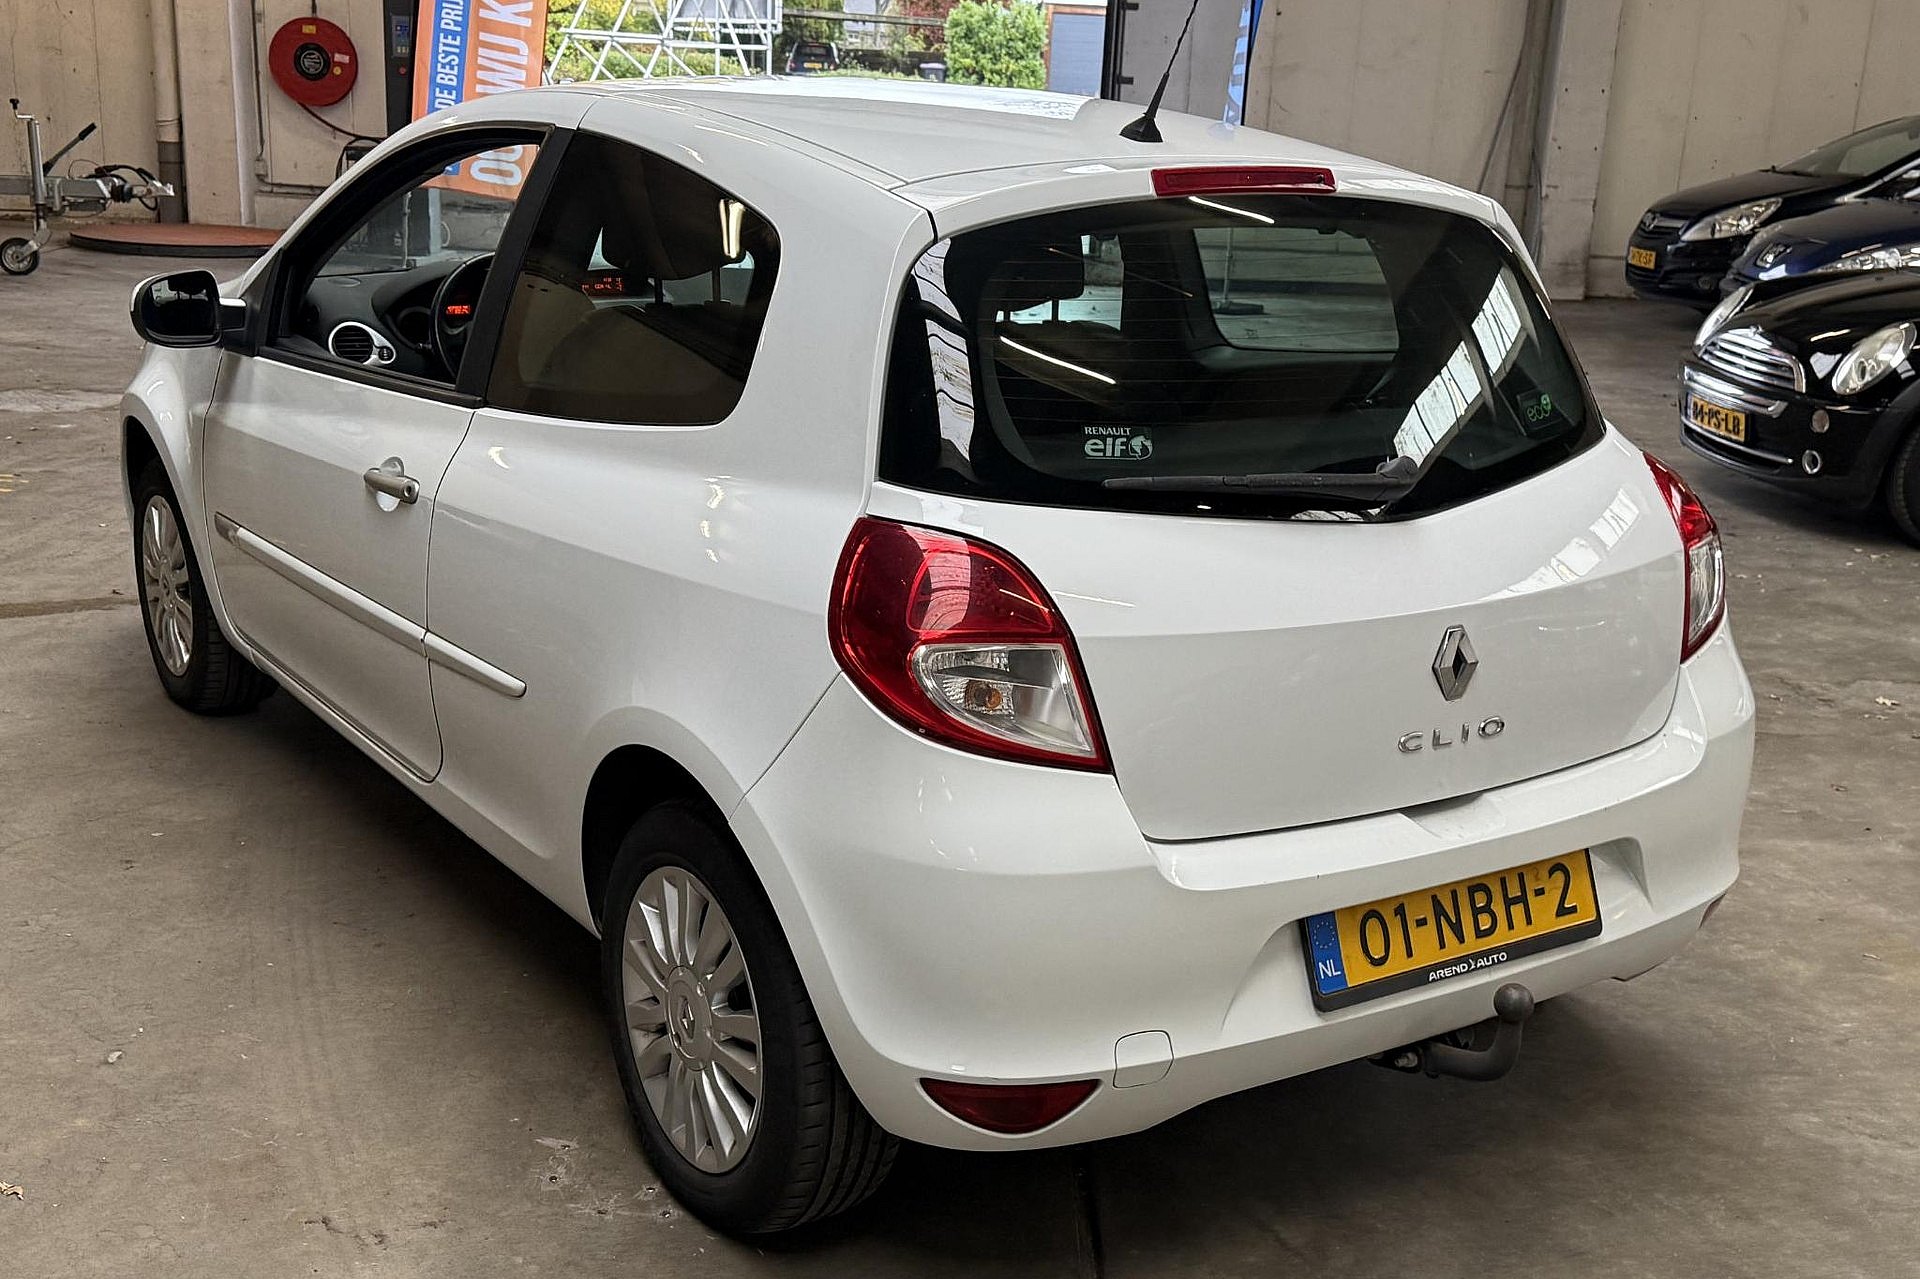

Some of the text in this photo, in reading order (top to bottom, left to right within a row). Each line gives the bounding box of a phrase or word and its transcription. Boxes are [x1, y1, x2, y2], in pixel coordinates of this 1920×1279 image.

[435, 33, 461, 87] BESTE
[475, 32, 529, 94] WIJ
[1084, 426, 1132, 436] RENAULT
[1084, 437, 1127, 457] elf
[1398, 716, 1504, 753] CLIO
[1359, 862, 1578, 967] 01-NBH-2
[1318, 961, 1341, 980] NL
[1428, 951, 1508, 982] AREND AUTO
